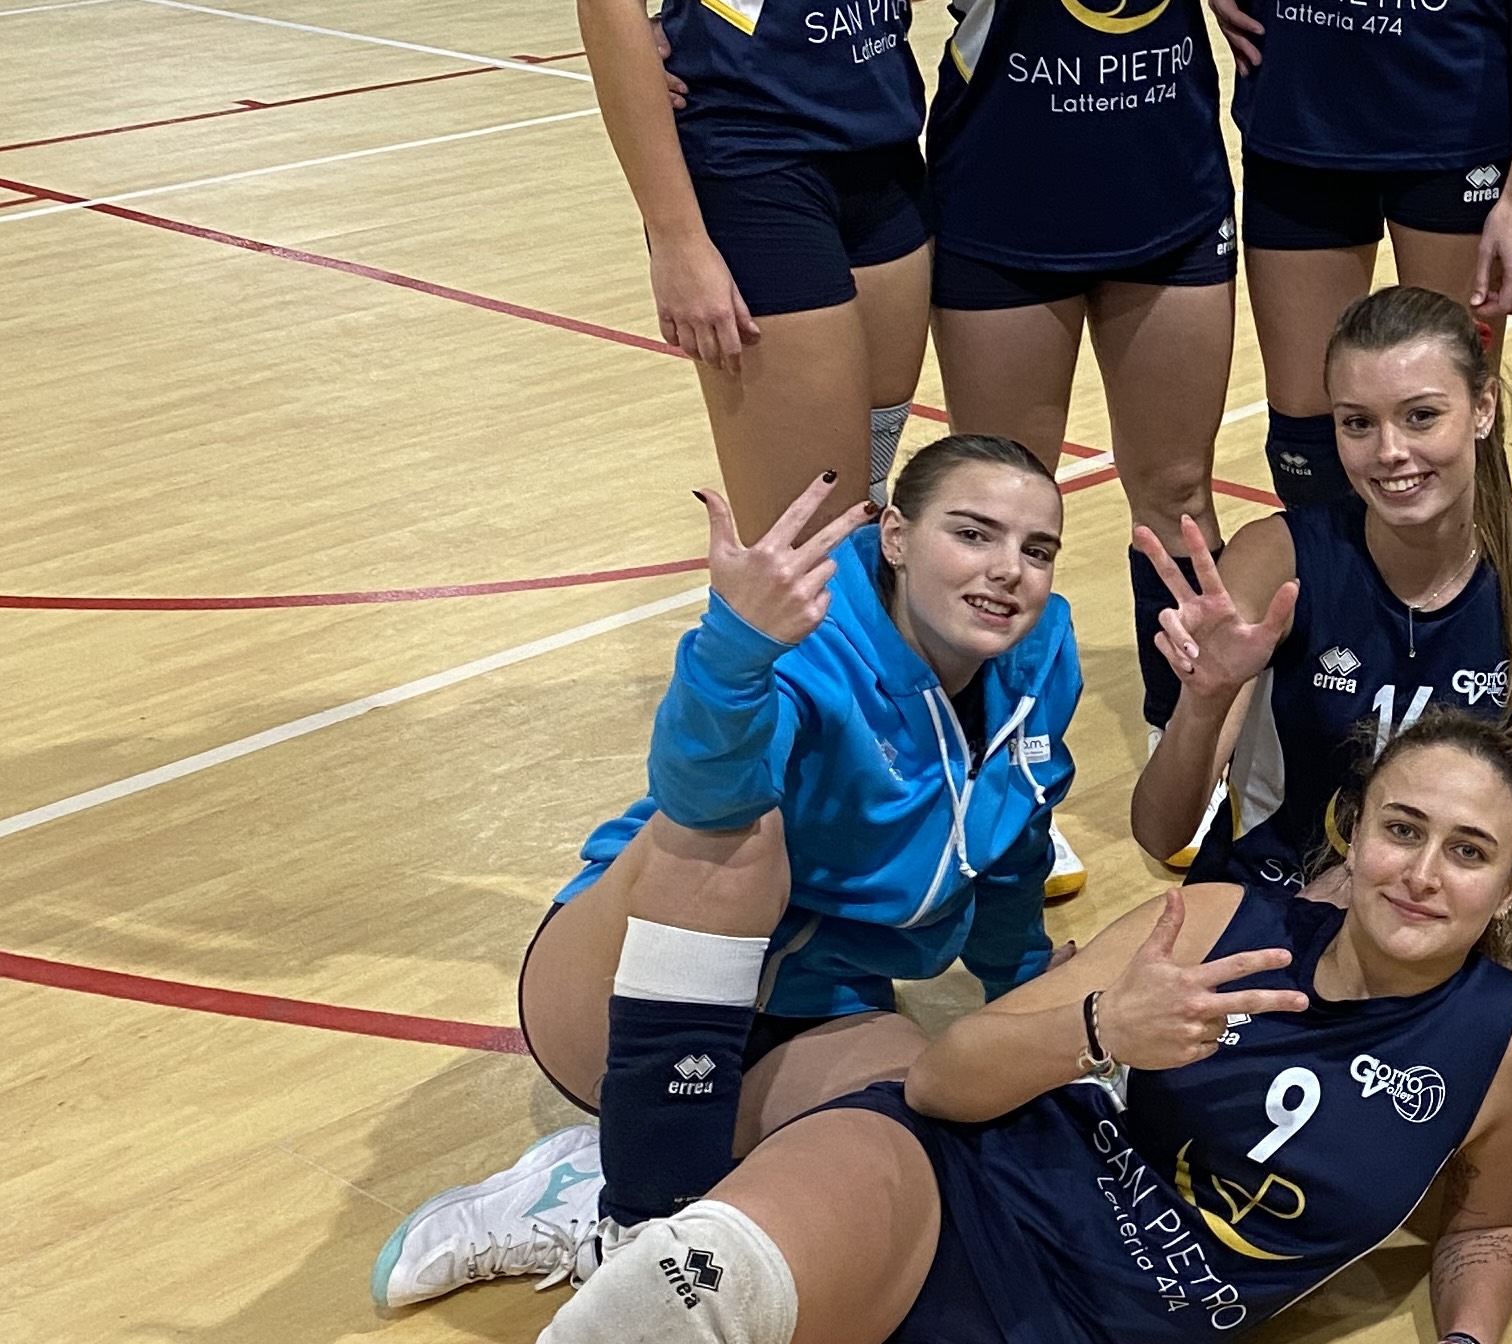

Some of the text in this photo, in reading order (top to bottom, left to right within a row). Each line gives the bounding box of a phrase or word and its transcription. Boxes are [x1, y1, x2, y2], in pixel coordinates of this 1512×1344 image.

[805, 0, 863, 44] SAN
[1275, 0, 1402, 36] Latteria 474
[1008, 36, 1194, 86] SAN PIETRO
[1051, 83, 1178, 113] Latteria 474
[1463, 187, 1500, 203] errea
[1313, 672, 1357, 694] errea
[1260, 858, 1306, 889] SA
[669, 1080, 713, 1095] errea
[1247, 1067, 1321, 1163] 9
[1094, 1120, 1247, 1331] SAN PIETRO
[660, 1257, 700, 1310] errea
[1156, 1276, 1190, 1313] 474
